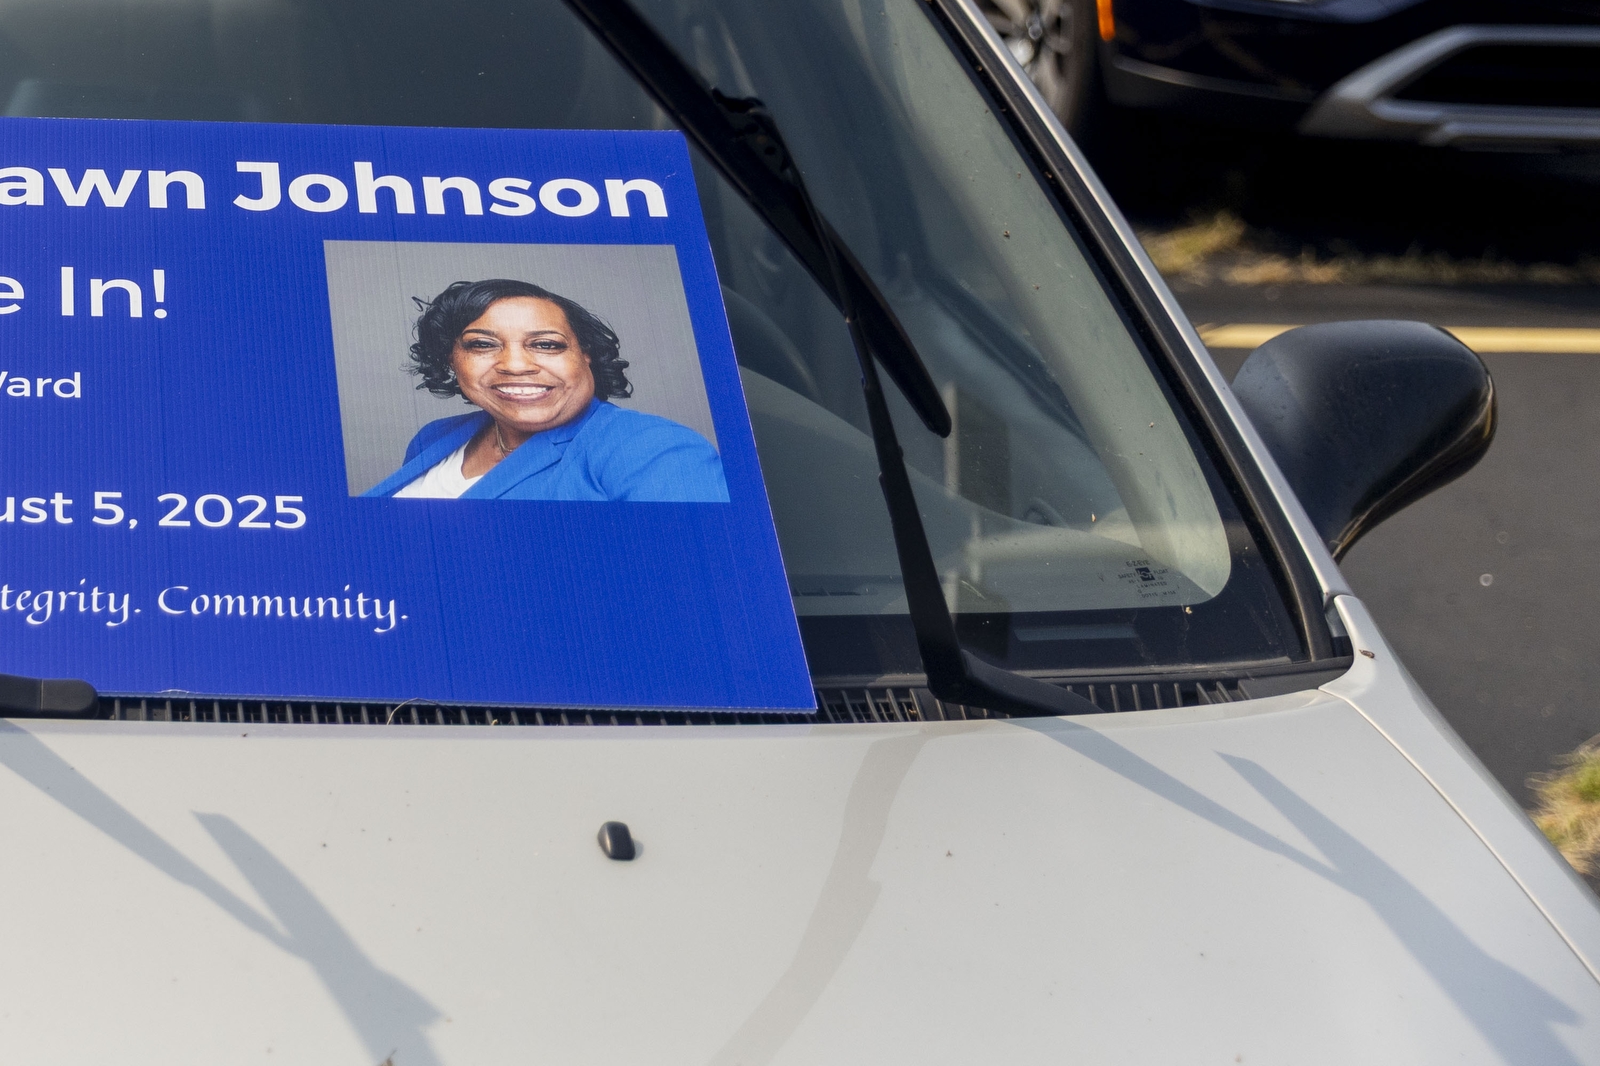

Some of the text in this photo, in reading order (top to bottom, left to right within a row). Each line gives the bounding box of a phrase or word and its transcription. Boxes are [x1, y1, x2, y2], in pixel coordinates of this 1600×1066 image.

[232, 161, 669, 218] Johnson
[60, 266, 168, 319] In!
[92, 491, 138, 530] 5,
[157, 492, 307, 530] 2025
[157, 584, 408, 634] Community.
